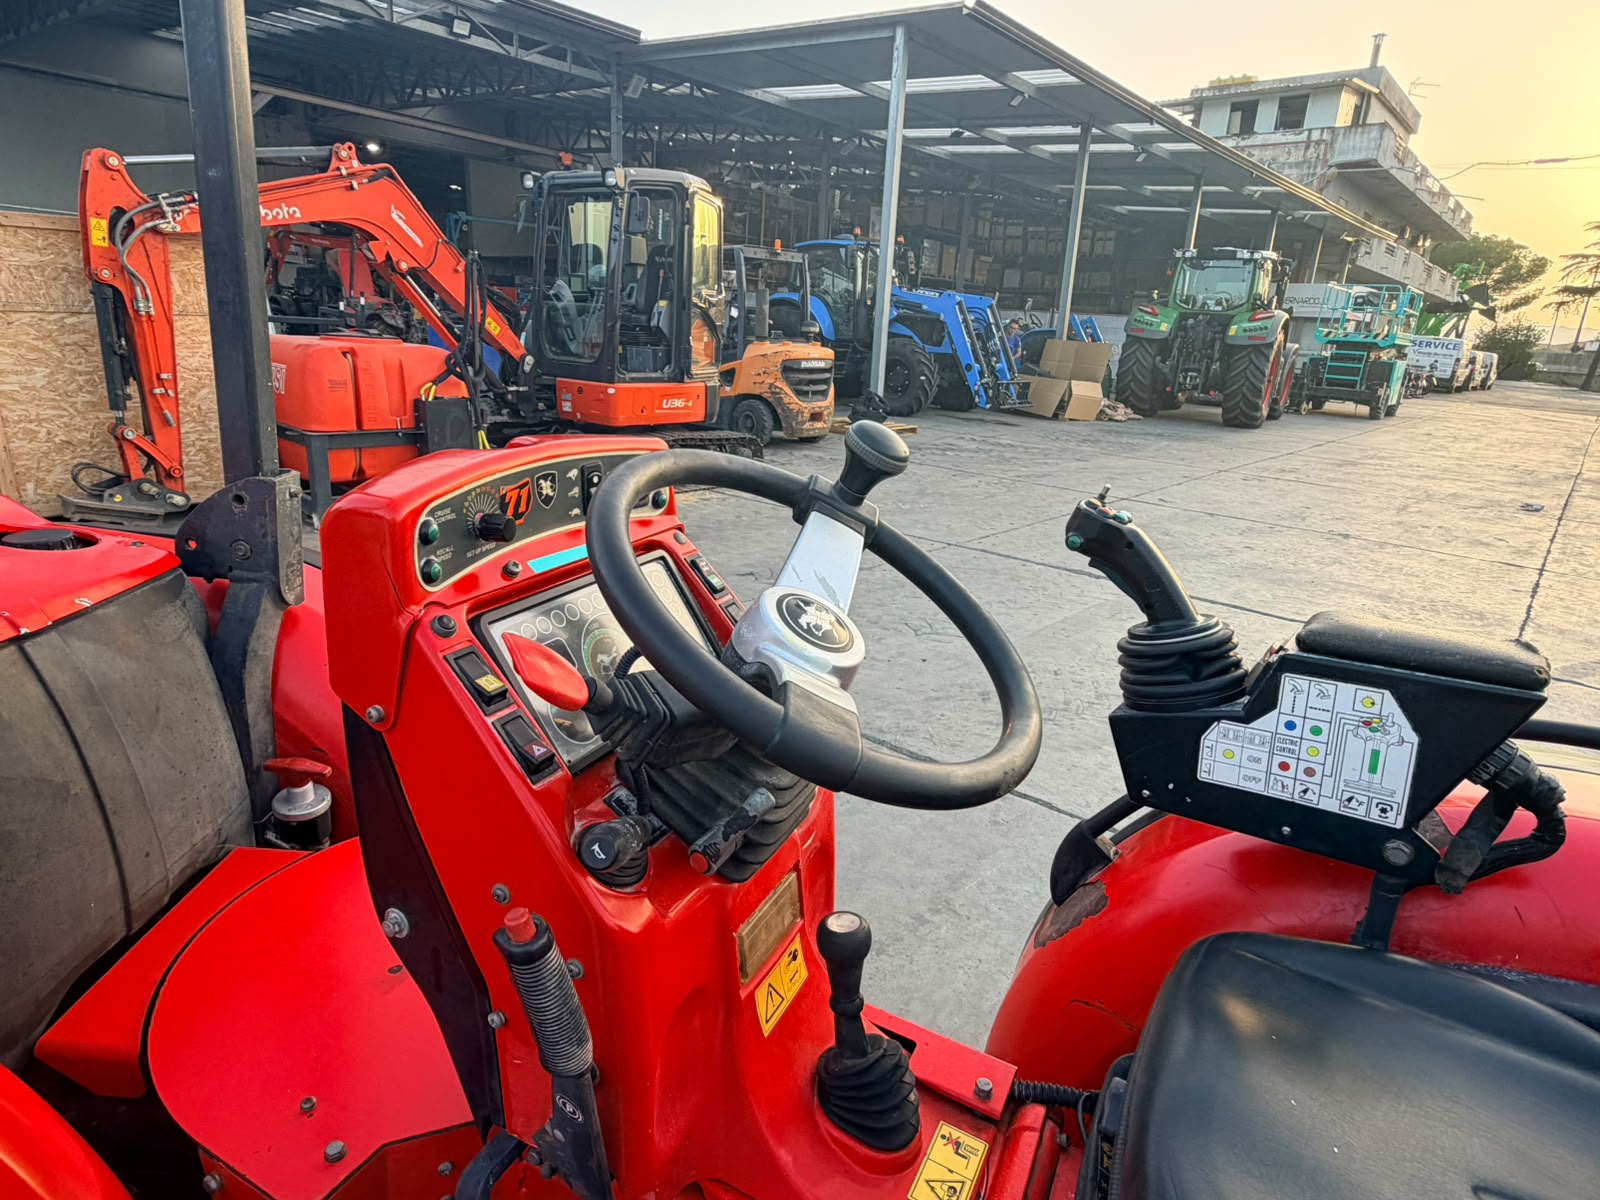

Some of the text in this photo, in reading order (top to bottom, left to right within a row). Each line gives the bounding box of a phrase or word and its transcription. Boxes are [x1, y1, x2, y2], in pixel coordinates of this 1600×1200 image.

[260, 203, 301, 221] bota
[1285, 296, 1320, 305] ERNARDO
[1410, 339, 1461, 351] SERVICE
[505, 485, 530, 517] 71
[434, 507, 452, 518] CRUISE
[435, 513, 457, 524] CONTROL
[436, 545, 455, 556] RECALL
[466, 549, 475, 558] SET
[437, 552, 453, 563] SPEED
[1276, 736, 1299, 748] ELECTRIC
[1275, 744, 1298, 756] CONTROL
